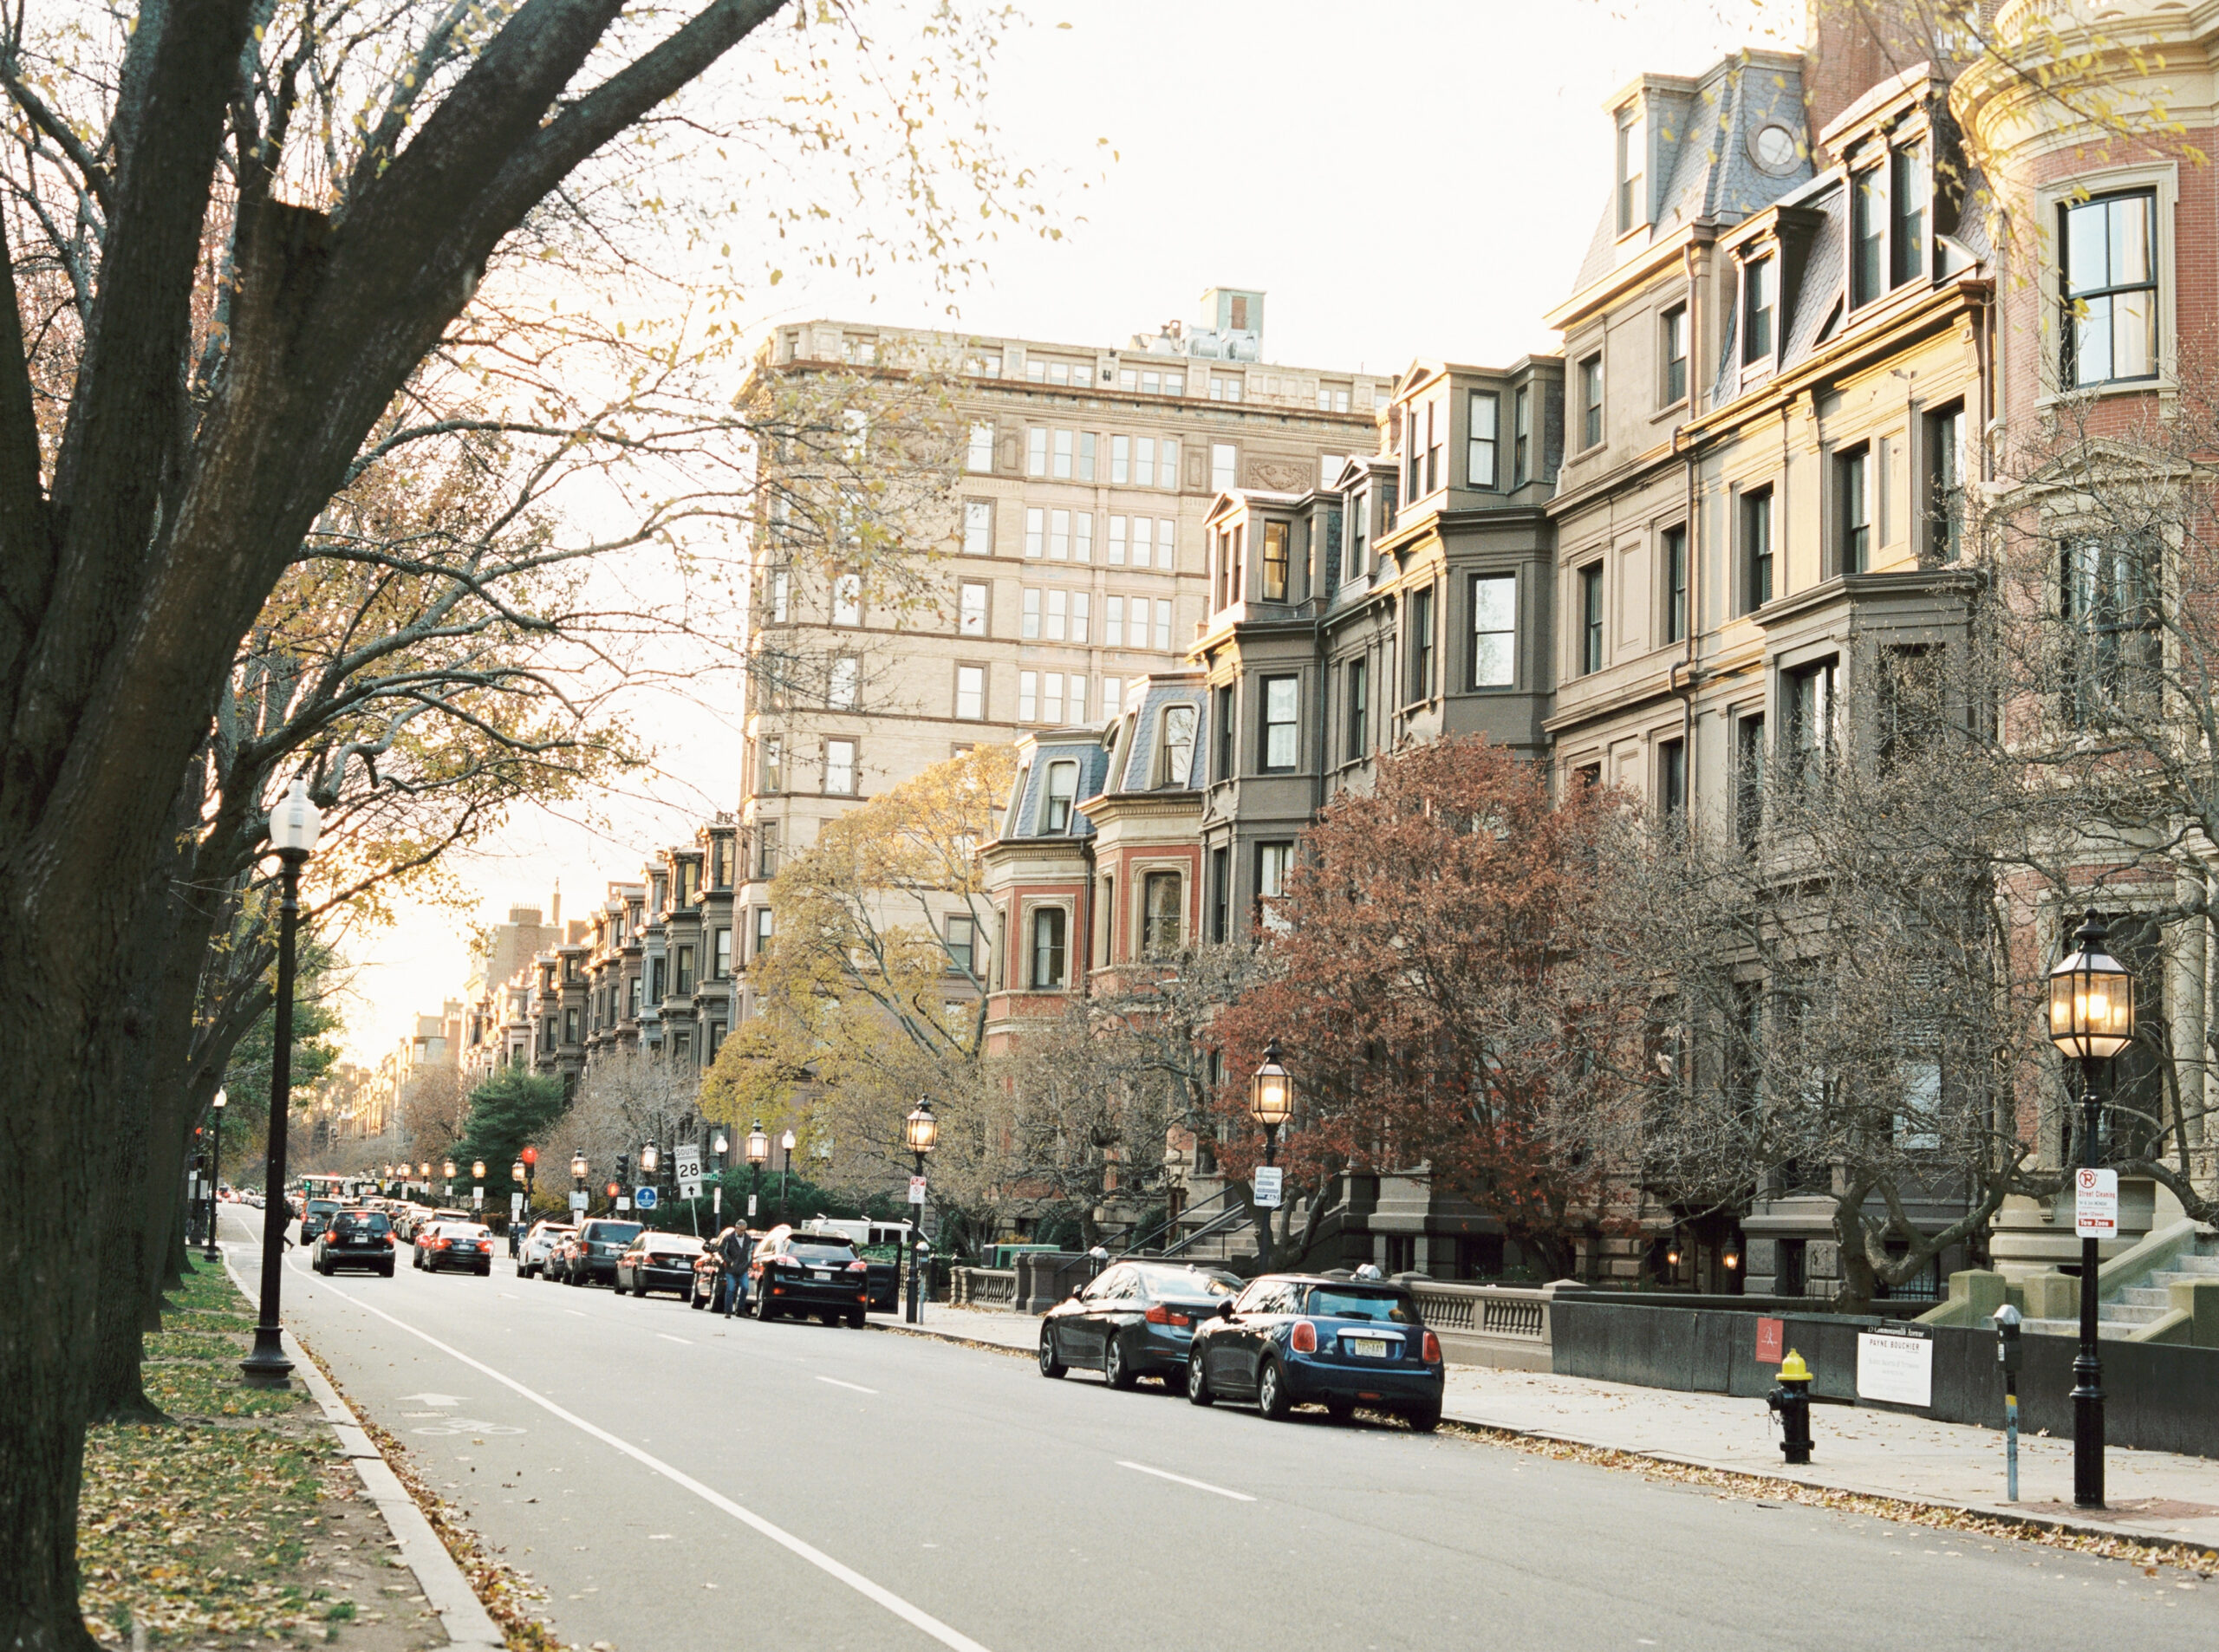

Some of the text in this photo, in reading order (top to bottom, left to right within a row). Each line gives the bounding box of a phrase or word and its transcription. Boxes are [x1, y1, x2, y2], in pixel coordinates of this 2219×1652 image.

[677, 1148, 697, 1156] SOUTH
[680, 1163, 699, 1177] 28
[1870, 1339, 1920, 1350] PAYNE BOUCHIER
